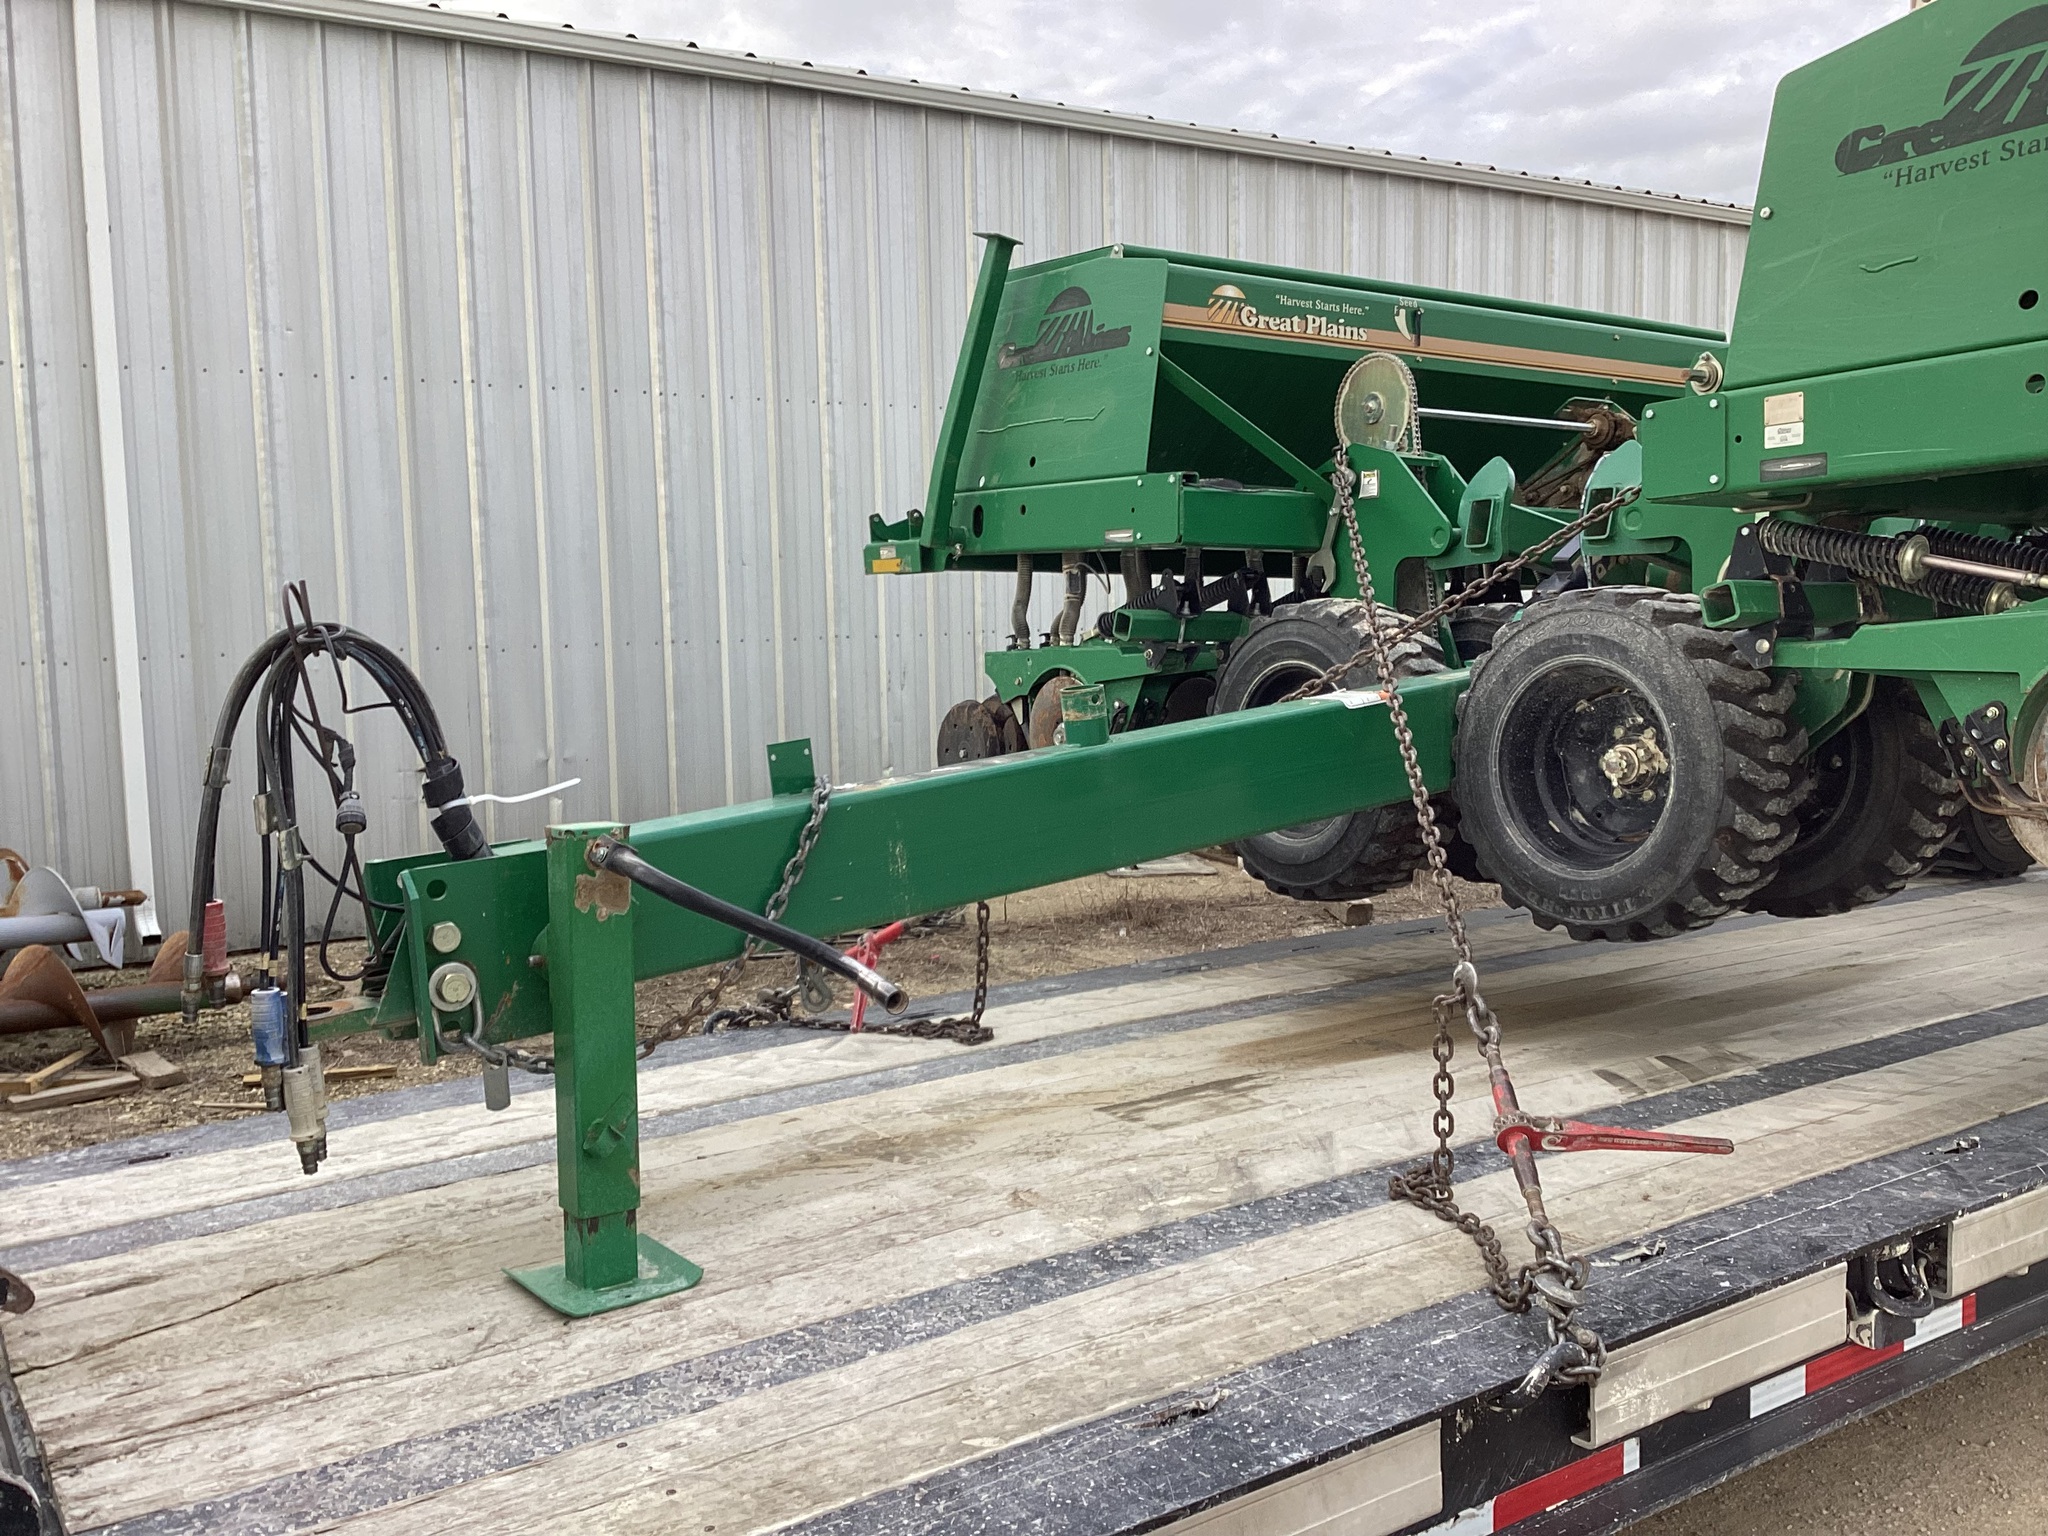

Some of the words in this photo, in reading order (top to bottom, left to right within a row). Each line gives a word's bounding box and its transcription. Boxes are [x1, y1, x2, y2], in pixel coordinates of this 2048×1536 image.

[1883, 149, 1992, 188] “Harvest
[1275, 294, 1313, 309] “Harvest
[1315, 299, 1341, 312] Starts
[1342, 303, 1370, 316] Here.”
[1399, 297, 1418, 308] Seed
[1239, 306, 1301, 334] Great
[1305, 314, 1368, 341] Plains
[1049, 361, 1076, 377] Starts
